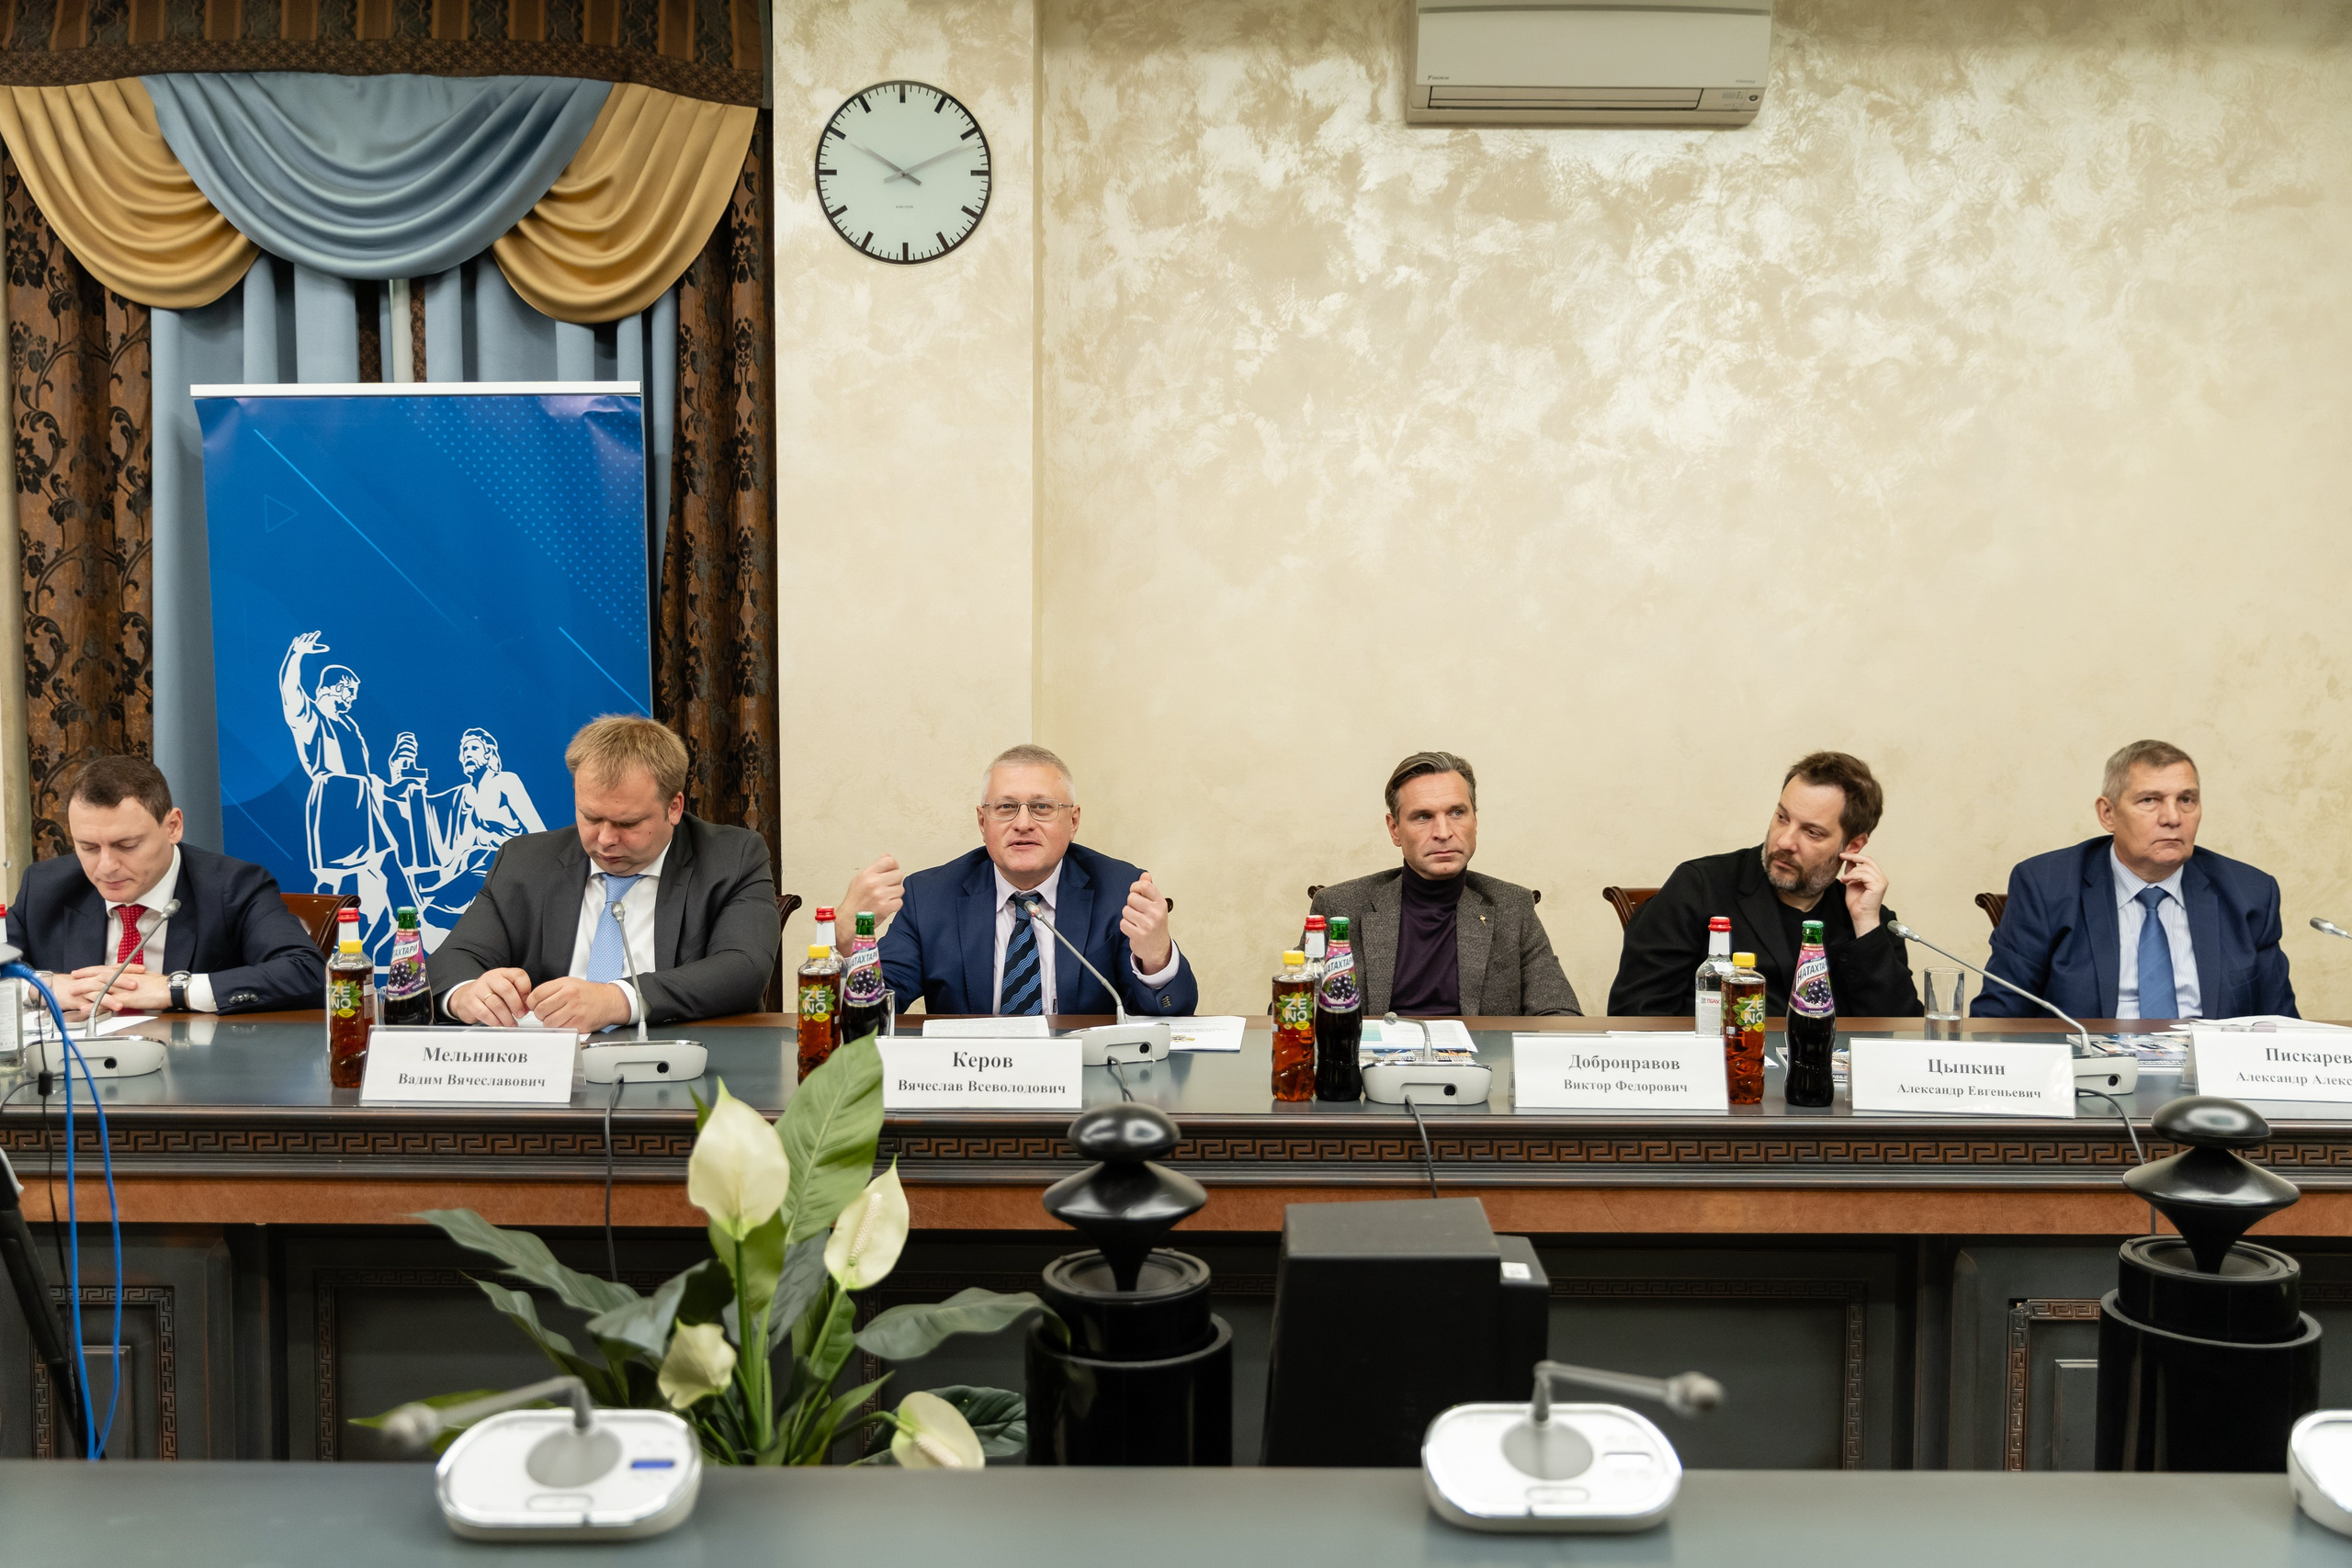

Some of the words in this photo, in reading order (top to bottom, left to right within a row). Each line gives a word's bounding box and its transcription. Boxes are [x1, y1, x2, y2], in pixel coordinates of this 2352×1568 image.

[804, 990, 826, 1001] ZE
[804, 1003, 827, 1013] NO
[1285, 998, 1306, 1010] ZE
[1744, 999, 1763, 1011] ZE
[1285, 1010, 1307, 1021] NO
[423, 1046, 528, 1064] Мельников
[952, 1051, 1013, 1073] Керов
[2265, 1047, 2352, 1067] Пискарев
[1568, 1054, 1680, 1073] Добронравов
[1928, 1058, 2006, 1078] Цыпкин
[398, 1073, 443, 1086] Вадим
[447, 1074, 546, 1088] Вячеславович
[898, 1078, 964, 1092] Вячеслав
[967, 1080, 1066, 1094] Всеволодович
[1564, 1078, 1611, 1093] Виктор
[1615, 1080, 1688, 1095] Федорович
[2236, 1071, 2308, 1087] Александр
[1896, 1083, 1964, 1098] Александр
[1968, 1085, 2041, 1100] Евгеньевич
